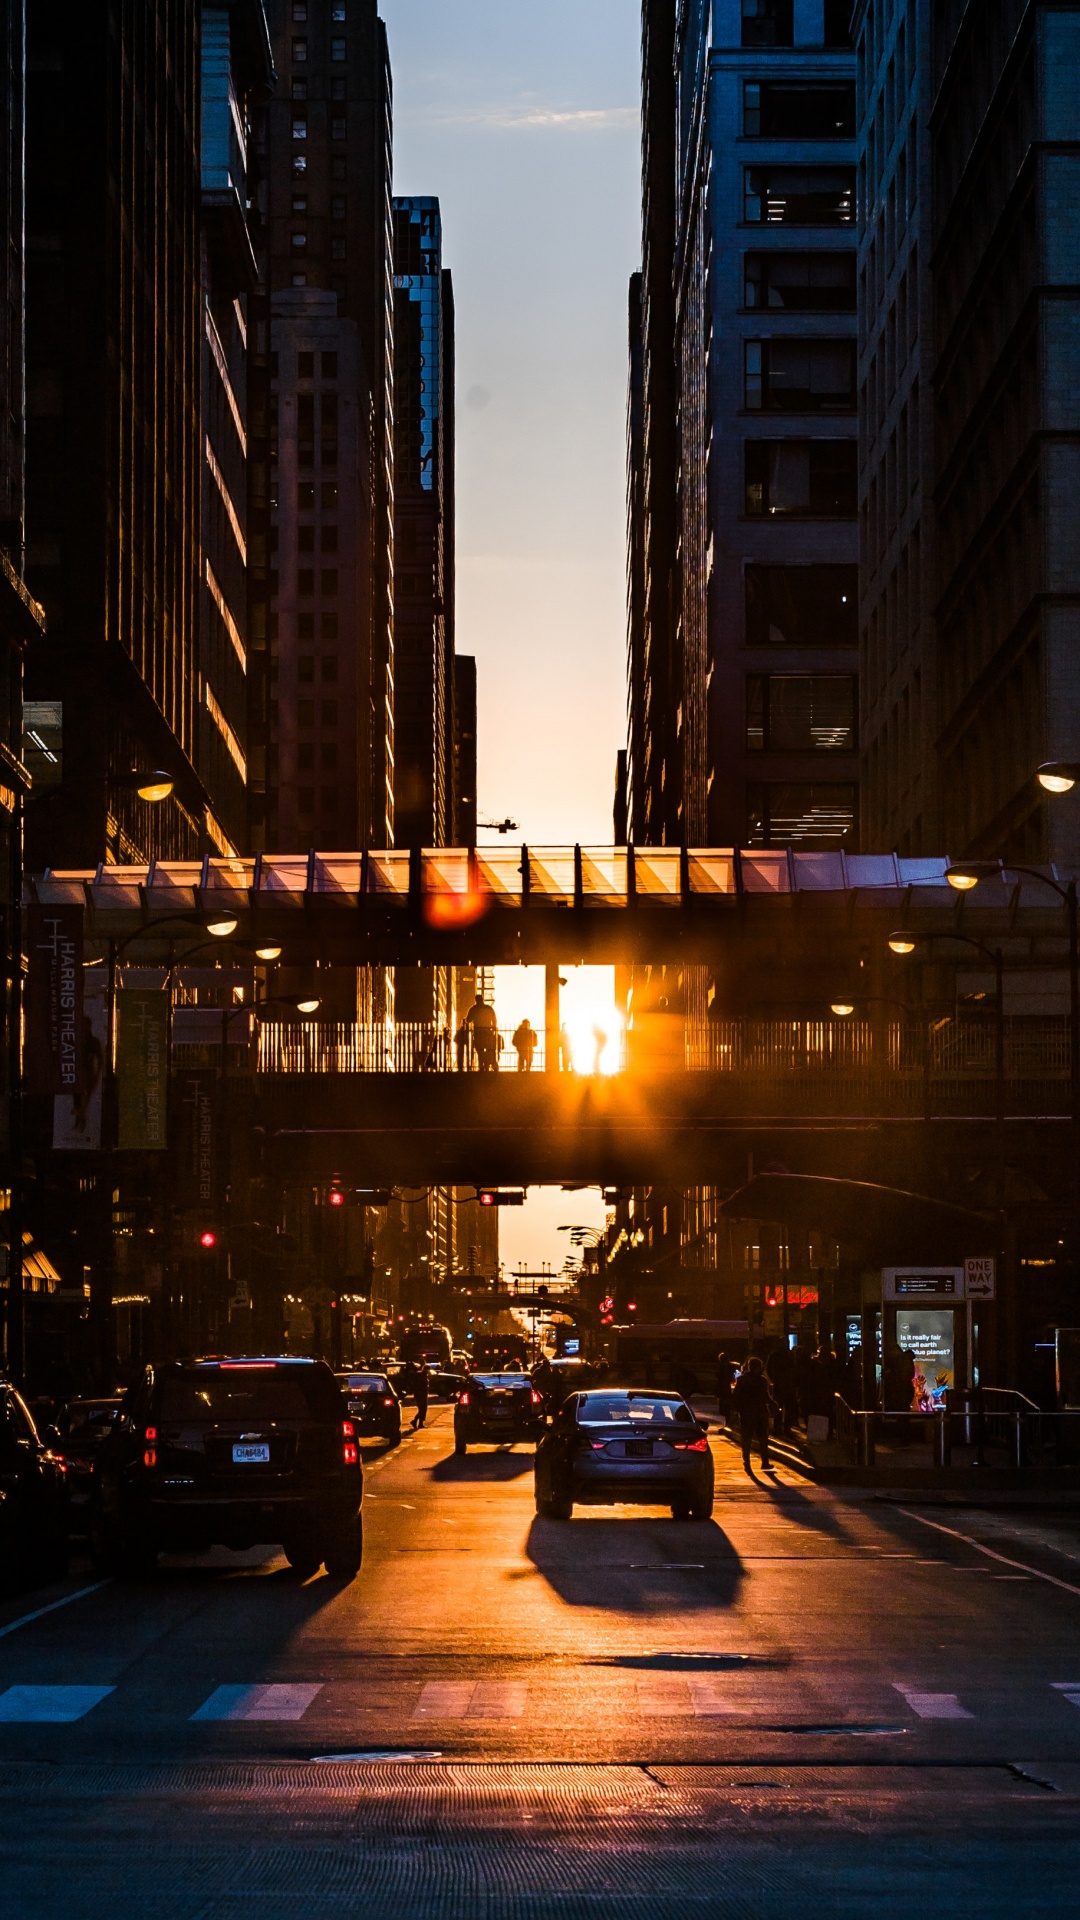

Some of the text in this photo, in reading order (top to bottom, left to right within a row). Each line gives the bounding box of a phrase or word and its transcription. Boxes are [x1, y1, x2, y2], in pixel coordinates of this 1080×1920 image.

[61, 943, 76, 1085] HARRIS THEATER
[147, 1021, 160, 1141] HARRIS THEATER
[200, 1097, 212, 1200] HARRIS THEATER
[968, 1260, 992, 1271] ONE
[968, 1272, 992, 1283] WAY
[912, 1334, 930, 1342] really
